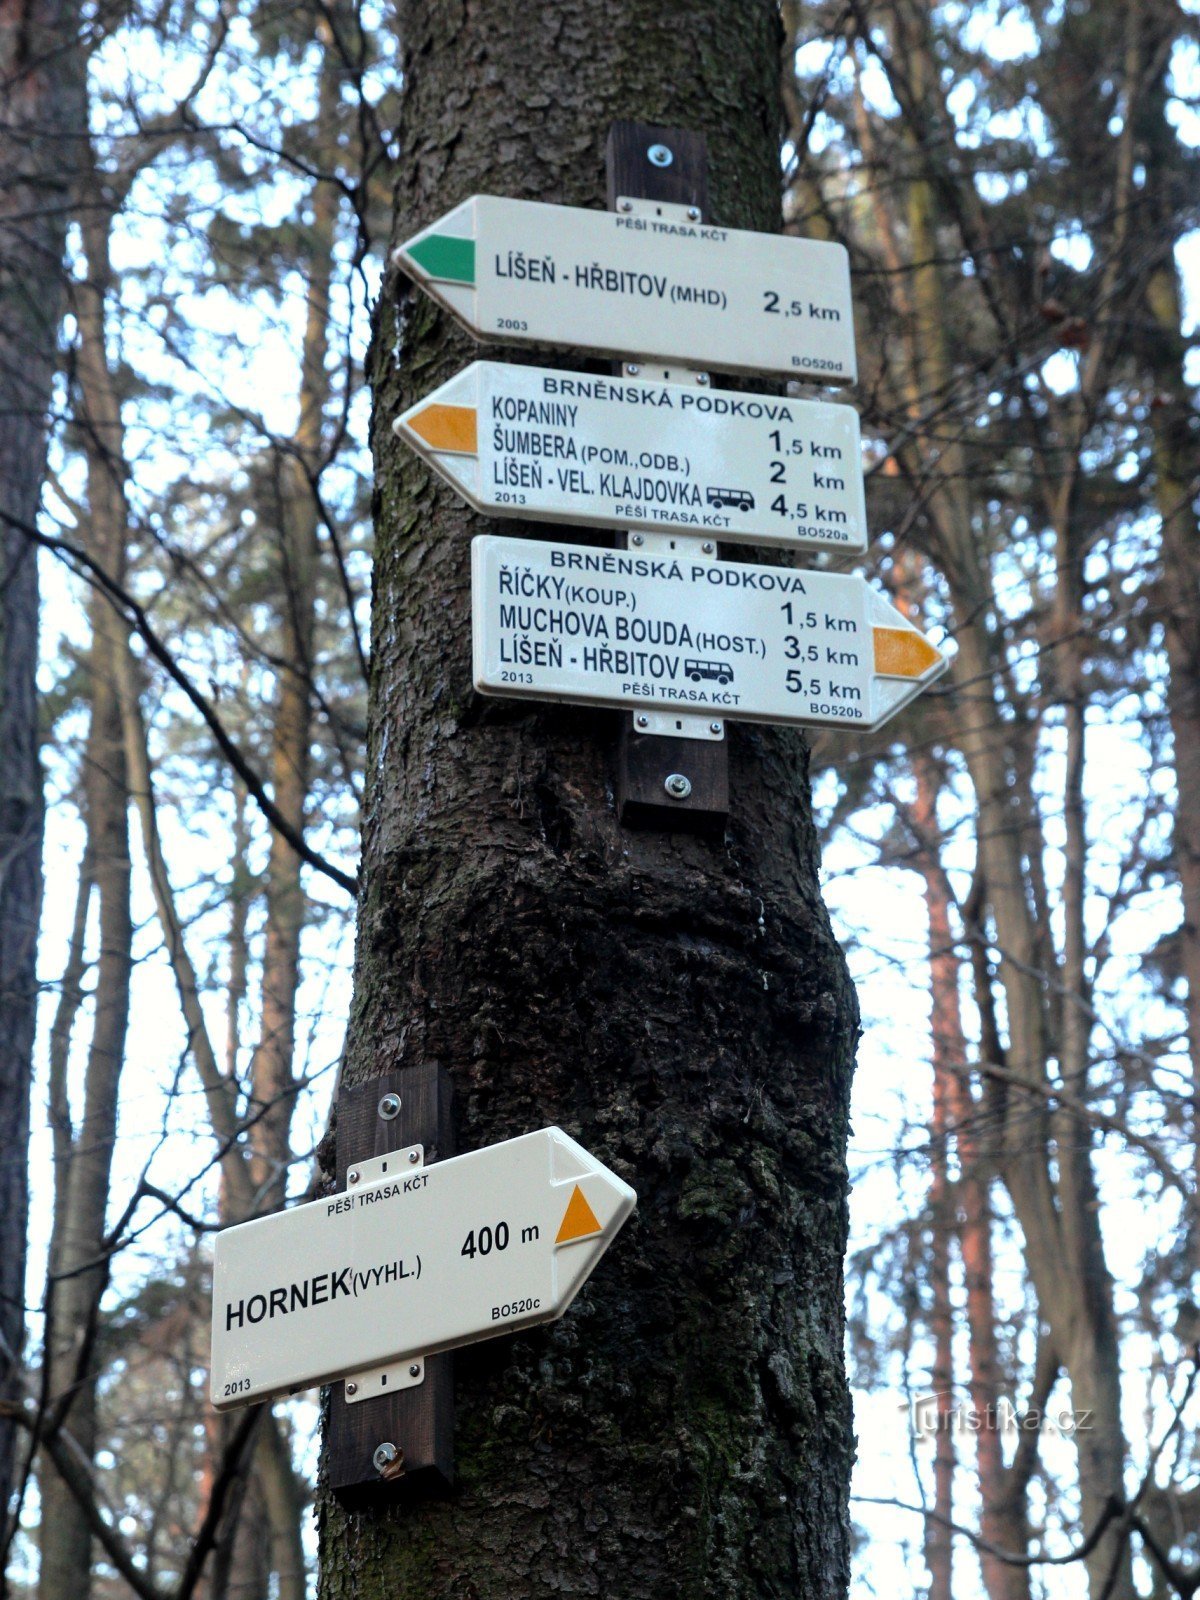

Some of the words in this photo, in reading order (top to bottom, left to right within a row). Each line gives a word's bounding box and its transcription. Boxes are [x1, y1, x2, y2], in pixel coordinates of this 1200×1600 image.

[651, 223, 697, 238] TRASA
[701, 228, 728, 242] KČT
[496, 250, 555, 284] LÍŠEŇ
[763, 291, 802, 317] 2,5
[809, 303, 841, 322] km
[497, 318, 528, 331] 2003
[543, 377, 673, 408] BRNĚNSKÁ
[681, 394, 793, 423] PODKOVA
[492, 396, 578, 428] KOPANINY
[769, 430, 803, 456] 1,5
[811, 441, 842, 460] km
[494, 457, 542, 489] LÍŠEŇ
[558, 468, 594, 495] VEL.
[600, 474, 703, 507] KLAJDOVKA
[771, 494, 807, 520] 4,5
[815, 505, 847, 523] km
[770, 461, 786, 484] 2
[814, 472, 845, 490] km
[495, 492, 526, 504] 2013
[616, 505, 647, 519] PĚŠÍ
[651, 509, 699, 524] TRASA
[703, 513, 731, 527] KČT
[551, 551, 683, 581] BRNĚNSKÁ
[692, 566, 806, 595] PODKOVA
[500, 604, 609, 639] MUCHOVA
[784, 635, 819, 663] 3,5
[827, 647, 859, 666] km
[781, 602, 817, 629] 1,5
[825, 614, 857, 633] km
[500, 634, 562, 668] LÍŠEŇ
[584, 642, 680, 680] HŘBITOV
[786, 670, 821, 697] 5,5
[830, 681, 861, 700] km
[501, 671, 534, 684] 2013
[623, 682, 655, 697] PĚŠÍ
[659, 687, 707, 702] TRASA
[712, 691, 741, 705] KČT
[327, 1196, 355, 1217] PĚŠÍ
[358, 1186, 400, 1207] TRASA
[404, 1174, 429, 1194] KČT
[461, 1221, 510, 1260] 400
[521, 1225, 540, 1244] m
[224, 1378, 251, 1397] 2013
